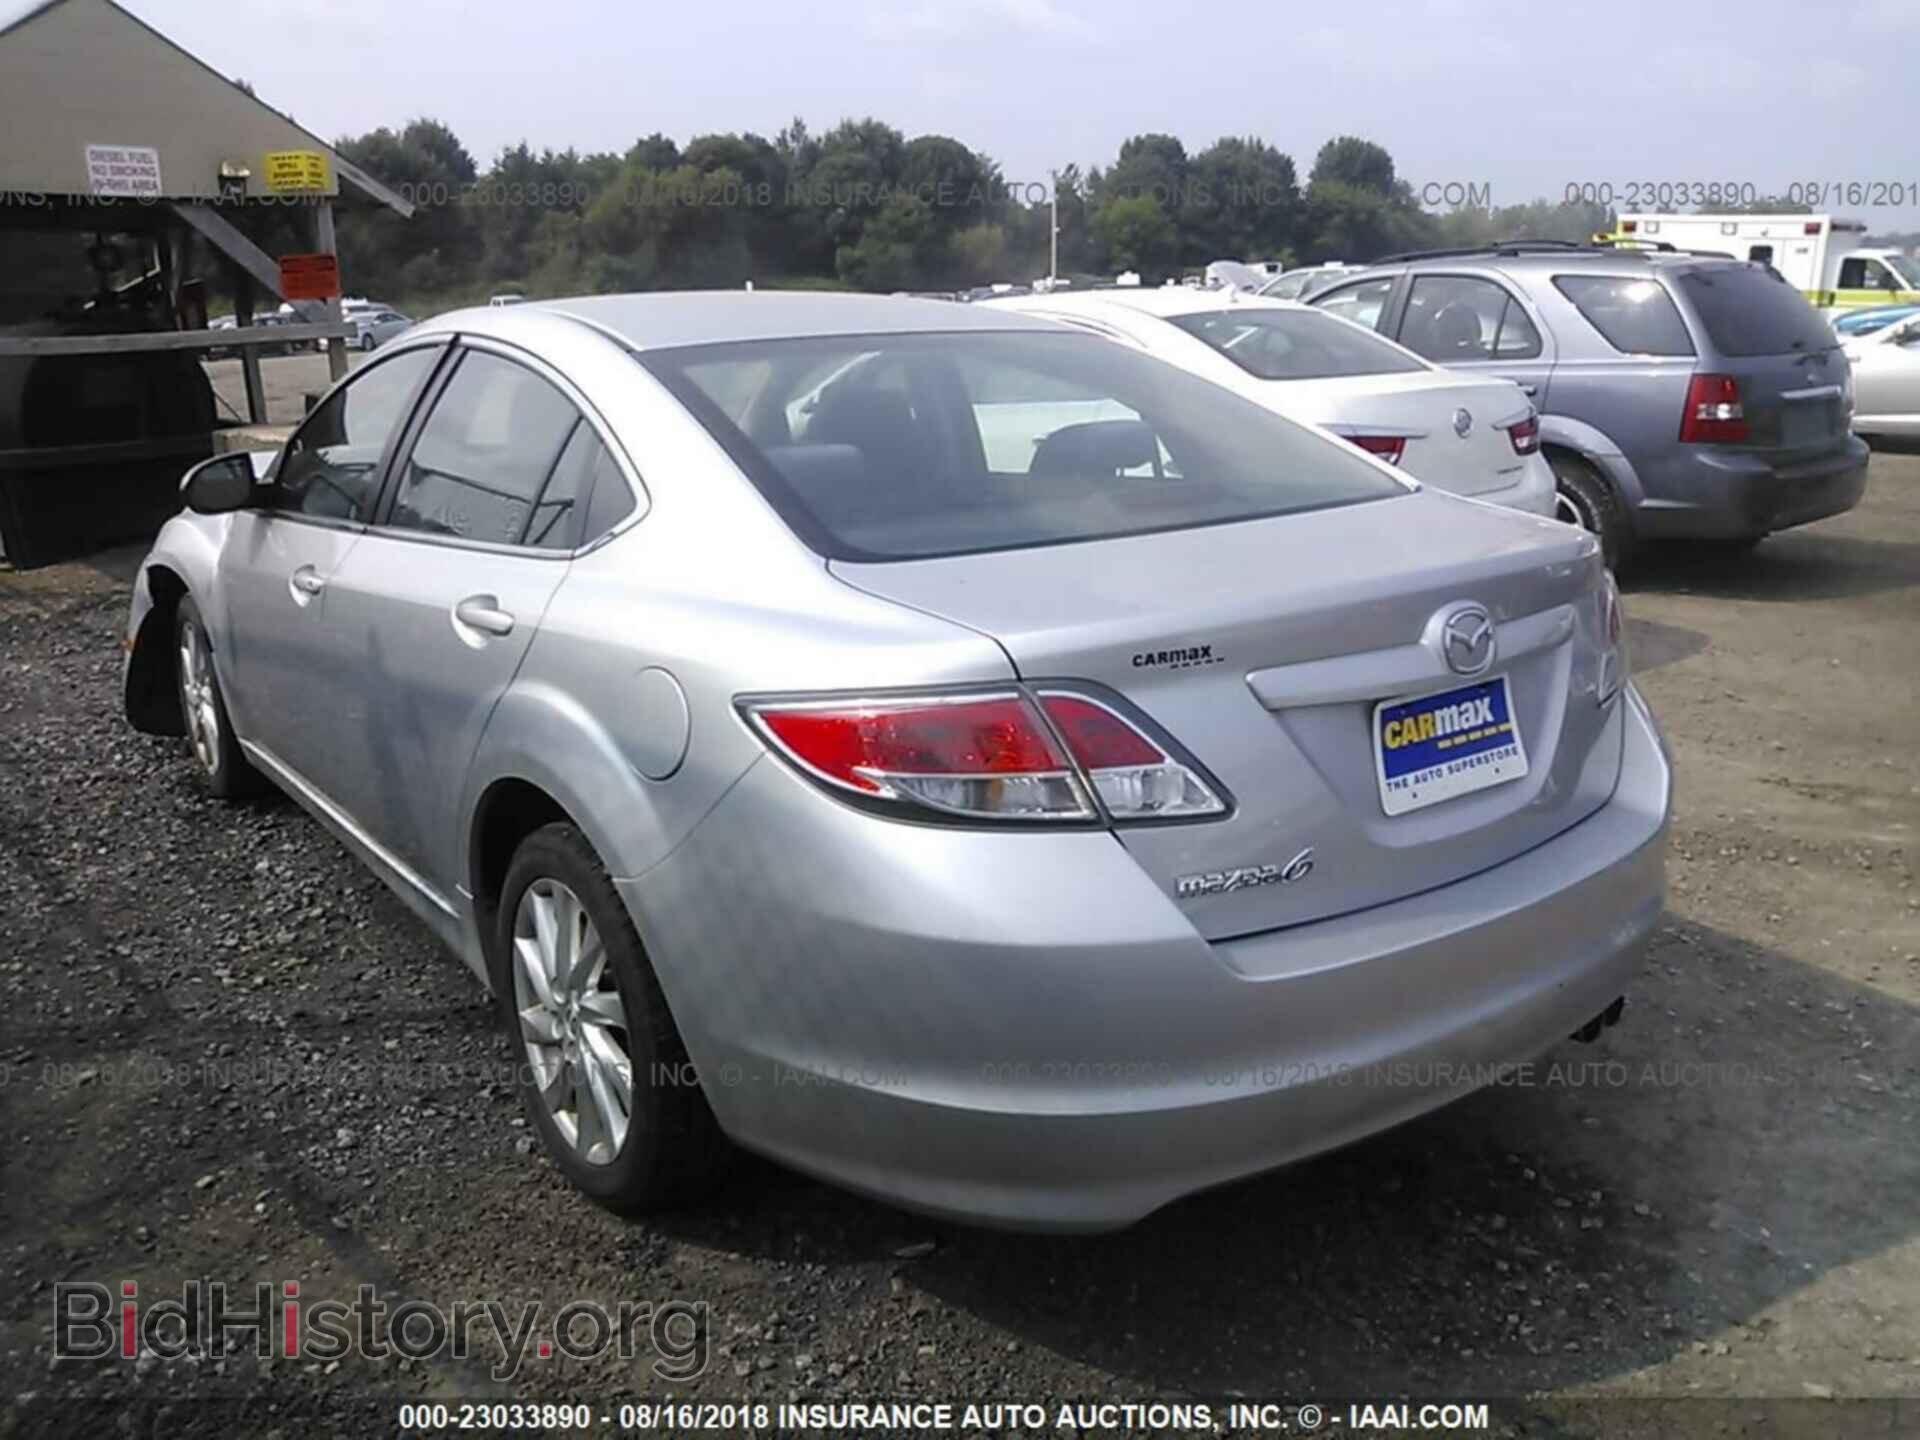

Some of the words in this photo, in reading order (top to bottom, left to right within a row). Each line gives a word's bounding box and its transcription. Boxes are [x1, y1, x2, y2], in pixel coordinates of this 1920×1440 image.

[128, 151, 155, 164] FUEL
[92, 165, 107, 177] NO
[110, 166, 157, 177] SMOKING
[1386, 777, 1409, 793] THE
[1414, 767, 1443, 785] AUTO
[1447, 746, 1519, 775] SUPERSTORE
